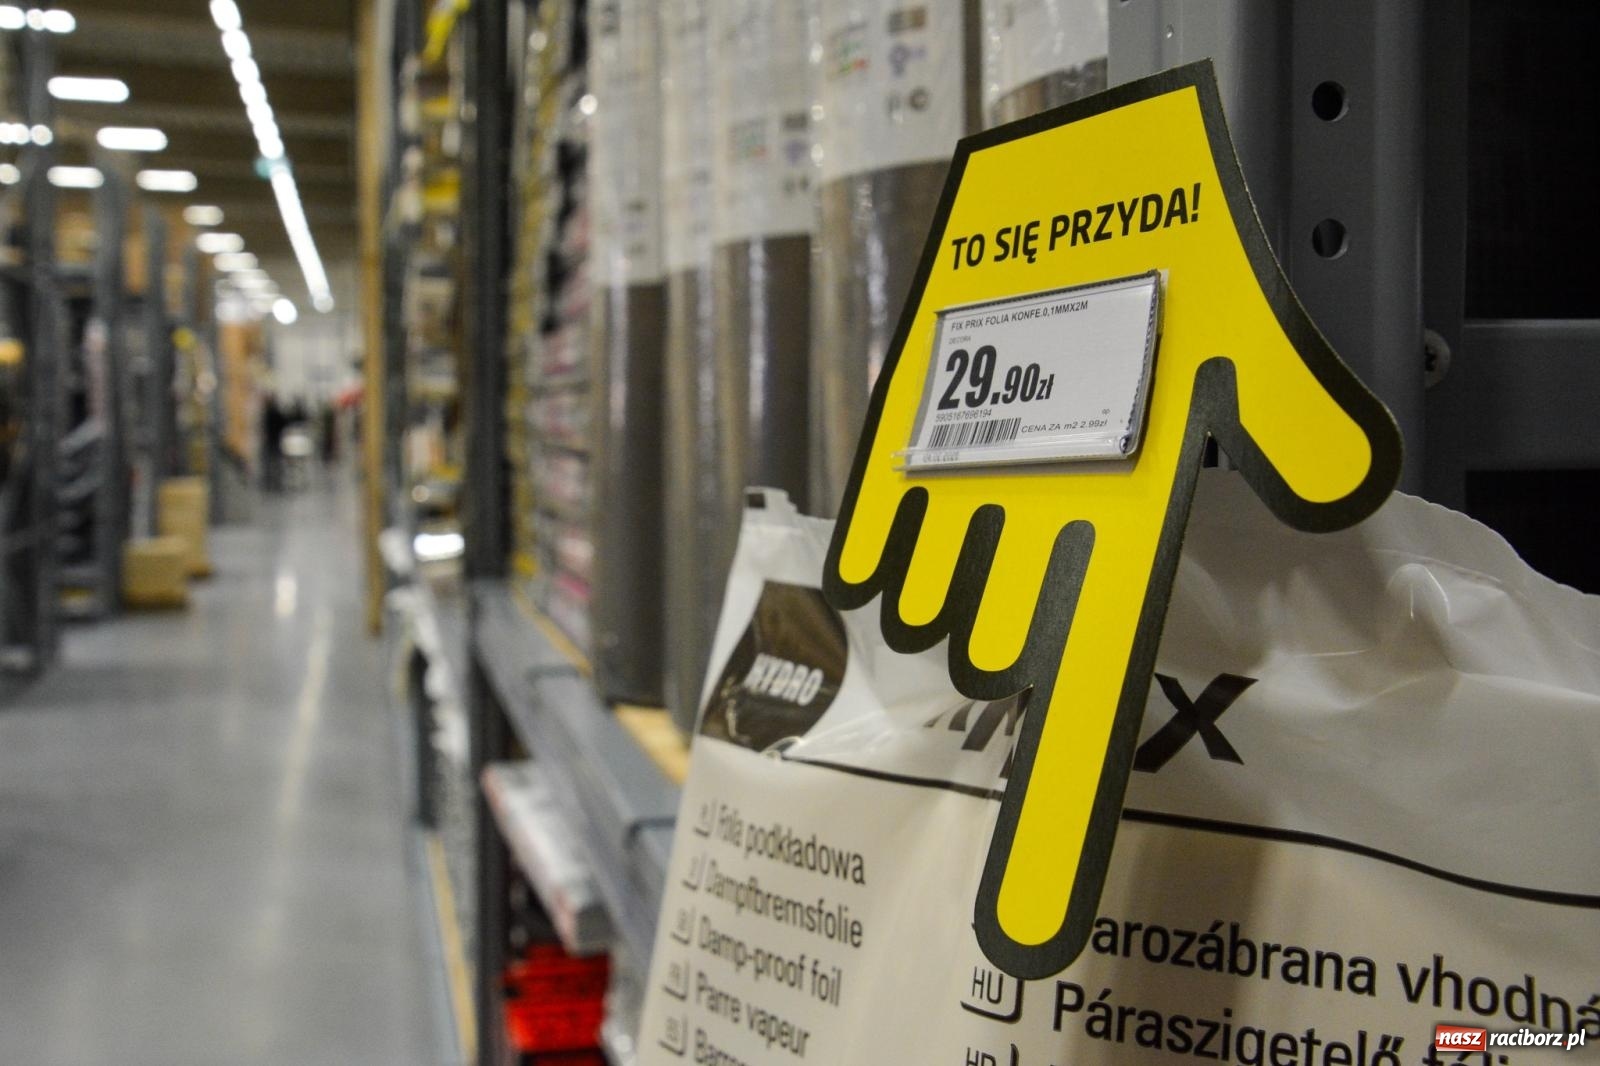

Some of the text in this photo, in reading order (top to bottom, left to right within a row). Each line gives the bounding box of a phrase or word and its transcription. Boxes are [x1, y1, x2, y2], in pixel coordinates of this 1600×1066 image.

[951, 182, 1202, 271] TO SIĘ PRZYDA!
[951, 319, 963, 332] FIX
[965, 316, 984, 330] PRIX
[985, 313, 1010, 327] FOLIA
[1021, 423, 1047, 434] CENA
[1048, 422, 1061, 432] ZA
[1063, 421, 1079, 430] m2
[743, 652, 824, 706] HYDRO
[717, 803, 744, 848] Folia
[744, 823, 867, 886] podkładowa
[704, 858, 864, 949] Dampfbremsfolie
[697, 914, 807, 991] Damp-proof
[810, 958, 842, 1008] foil
[970, 965, 1004, 1005] HU
[1091, 915, 1600, 1041] arozábrana vhodná
[745, 1001, 811, 1059] vapeur
